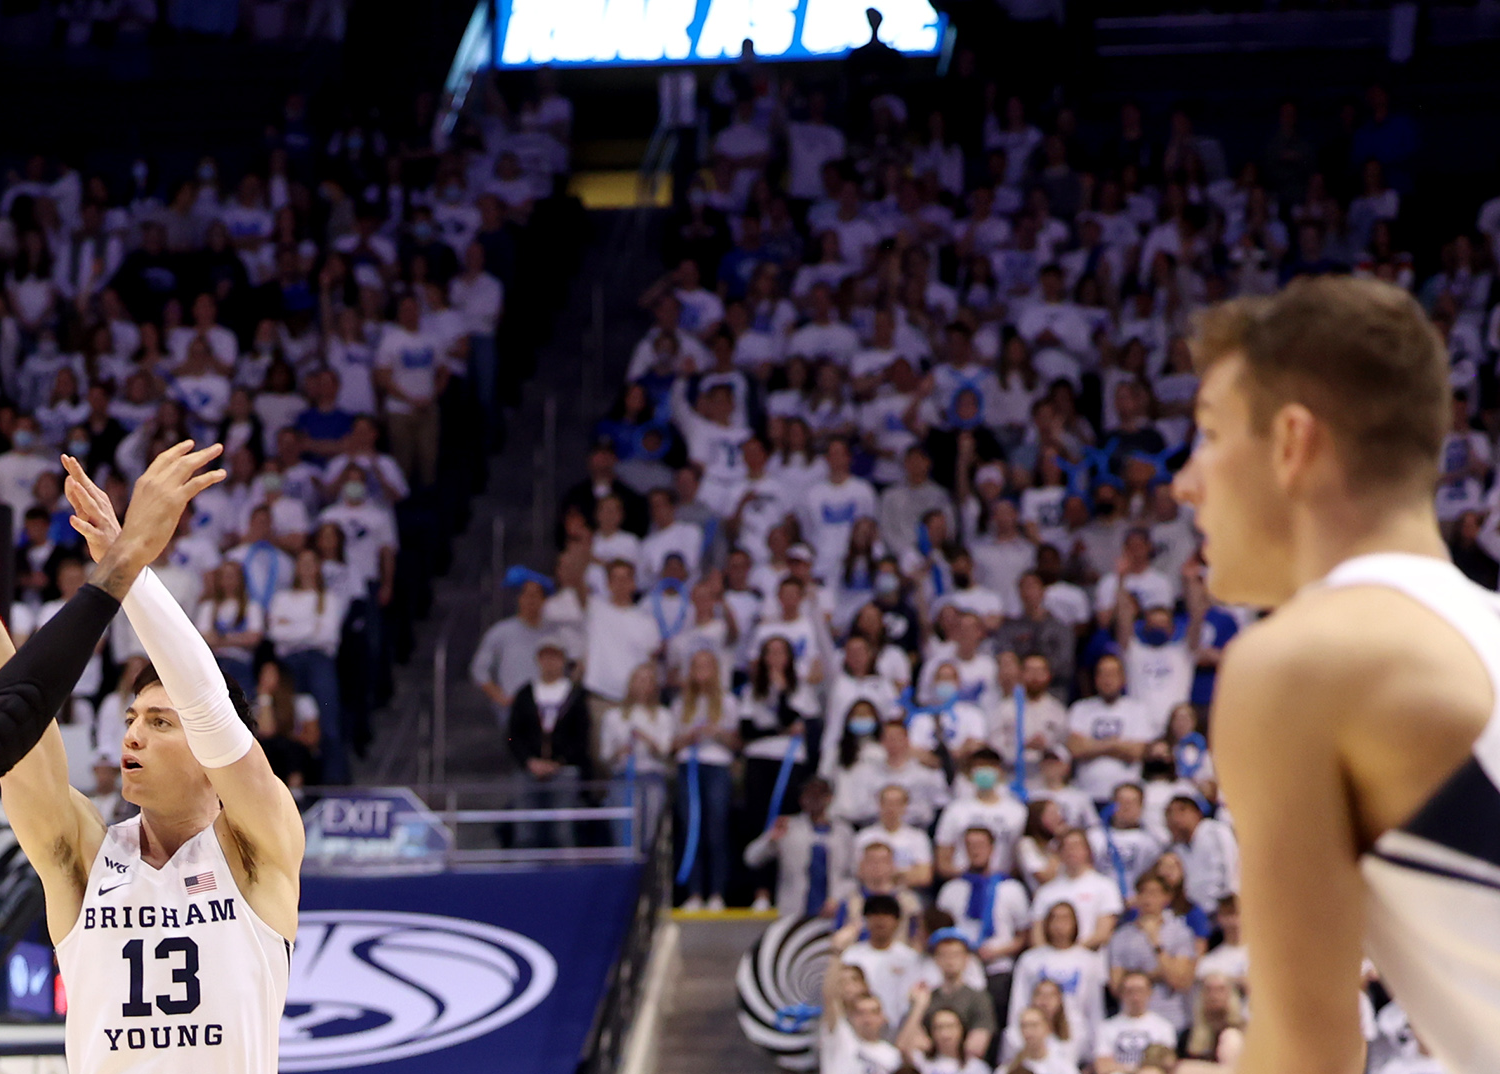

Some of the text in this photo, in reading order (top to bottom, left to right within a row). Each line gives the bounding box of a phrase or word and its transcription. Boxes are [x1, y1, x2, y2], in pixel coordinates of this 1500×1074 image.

[321, 799, 391, 834] EXIT
[84, 898, 237, 930] BRIGHAM
[121, 936, 201, 1018] 13
[104, 1023, 223, 1051] YOUNG
